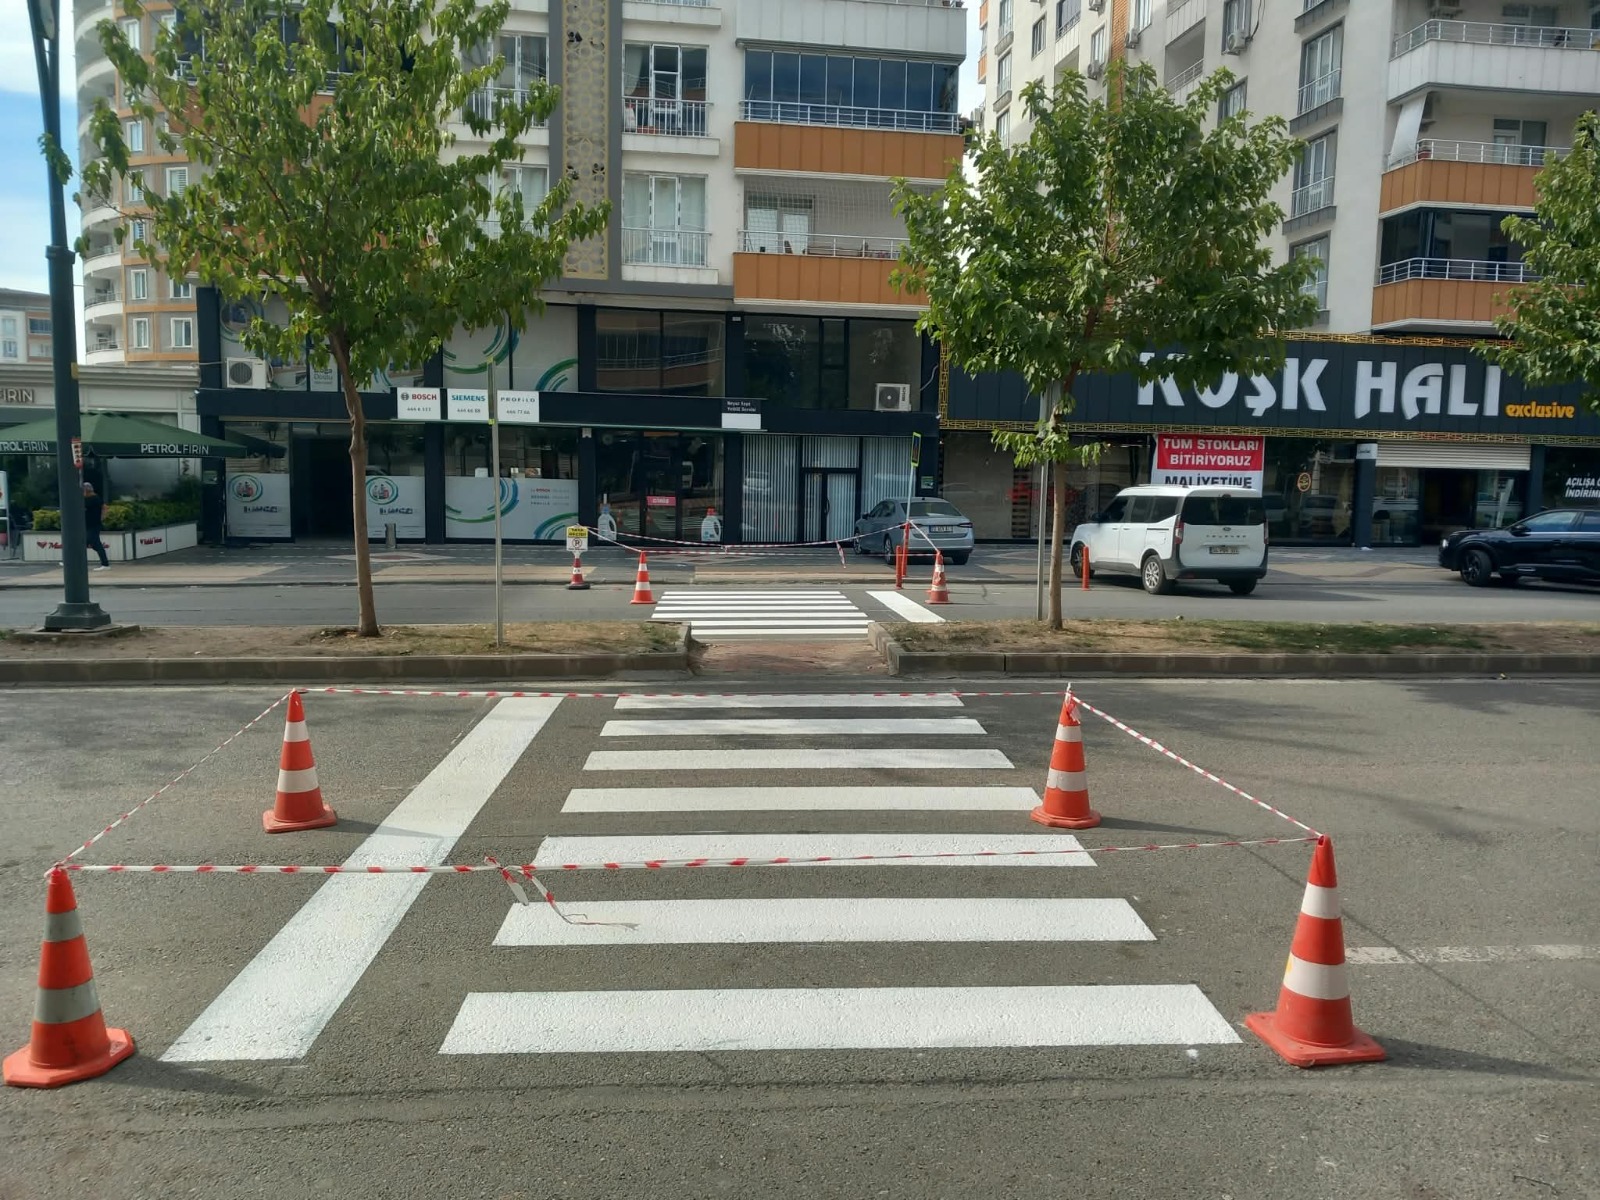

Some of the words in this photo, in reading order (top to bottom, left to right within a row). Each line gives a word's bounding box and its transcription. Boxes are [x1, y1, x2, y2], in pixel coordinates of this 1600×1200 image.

[411, 393, 437, 401] BOSCH
[451, 394, 486, 402] SIEMENS
[1354, 360, 1502, 421] HALI
[1505, 401, 1576, 419] exclusive
[1163, 436, 1193, 450] TÜM
[1197, 438, 1260, 451] STOKLARI
[1170, 451, 1252, 466] BİTİRİYORUZ
